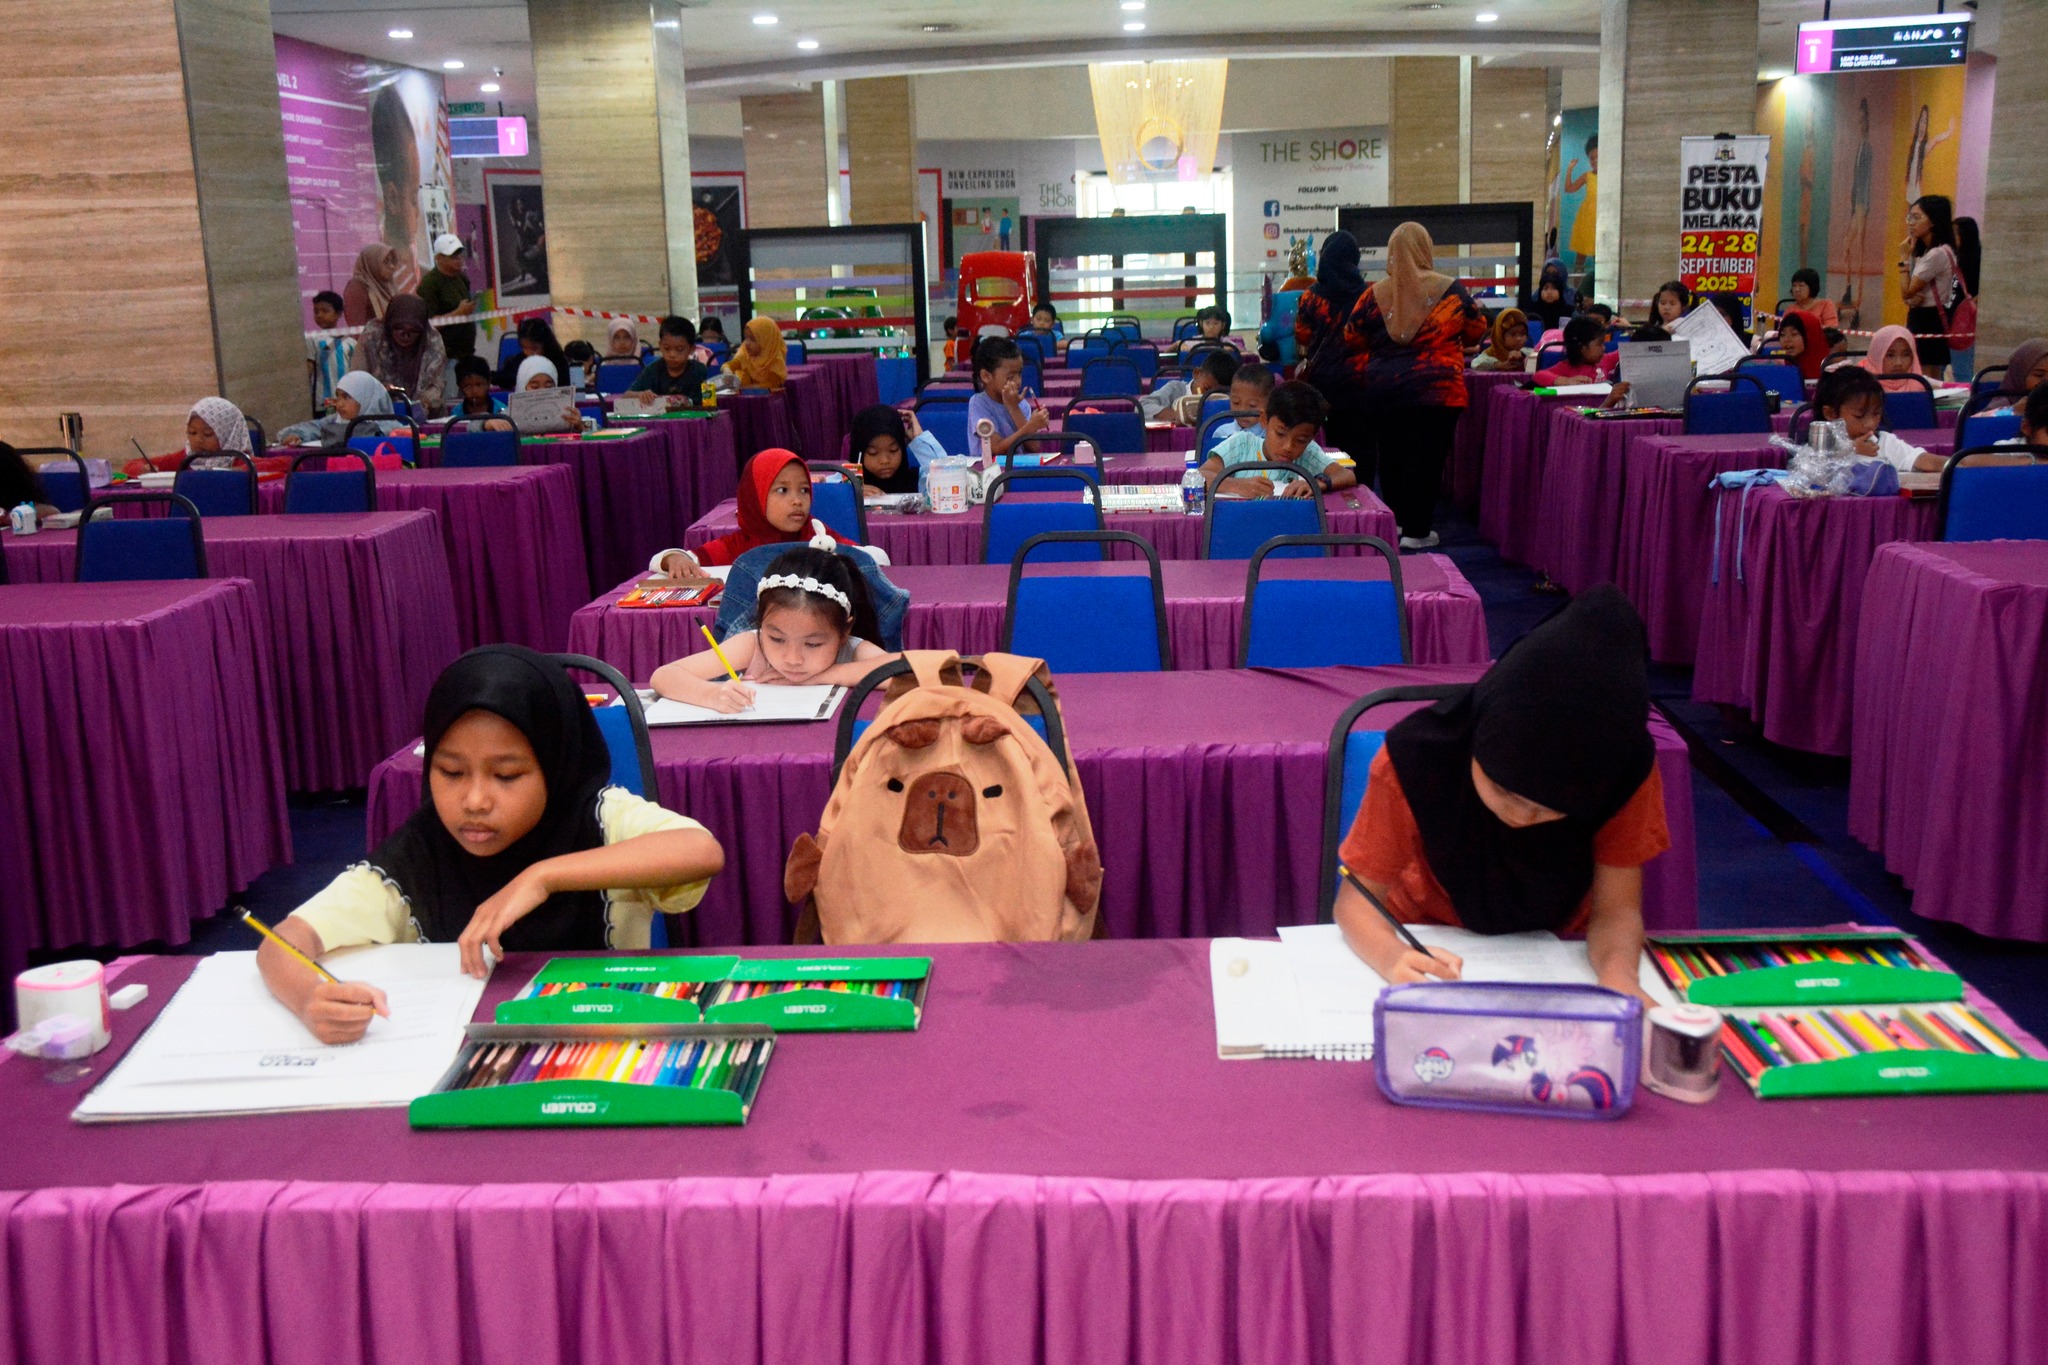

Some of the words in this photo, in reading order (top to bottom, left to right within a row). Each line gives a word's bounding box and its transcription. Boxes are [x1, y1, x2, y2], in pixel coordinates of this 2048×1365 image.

[1809, 45, 1817, 64] 1
[1260, 141, 1300, 162] THE
[1310, 139, 1381, 161] SHORE
[948, 170, 965, 179] NEW
[968, 169, 1015, 179] EXPERIENCE
[1688, 165, 1759, 185] PESTA
[948, 180, 991, 190] UNVEILING
[995, 180, 1016, 189] SOON
[1039, 183, 1062, 195] THE
[1683, 186, 1763, 211] BUKU
[1682, 213, 1759, 230] MELAKA
[1681, 257, 1754, 274] SEPTEMBER
[1696, 275, 1738, 292] 2025
[572, 1004, 614, 1013] COLLEEN
[783, 1004, 827, 1014] COLLEEN
[541, 1101, 597, 1114] COLLEEN
